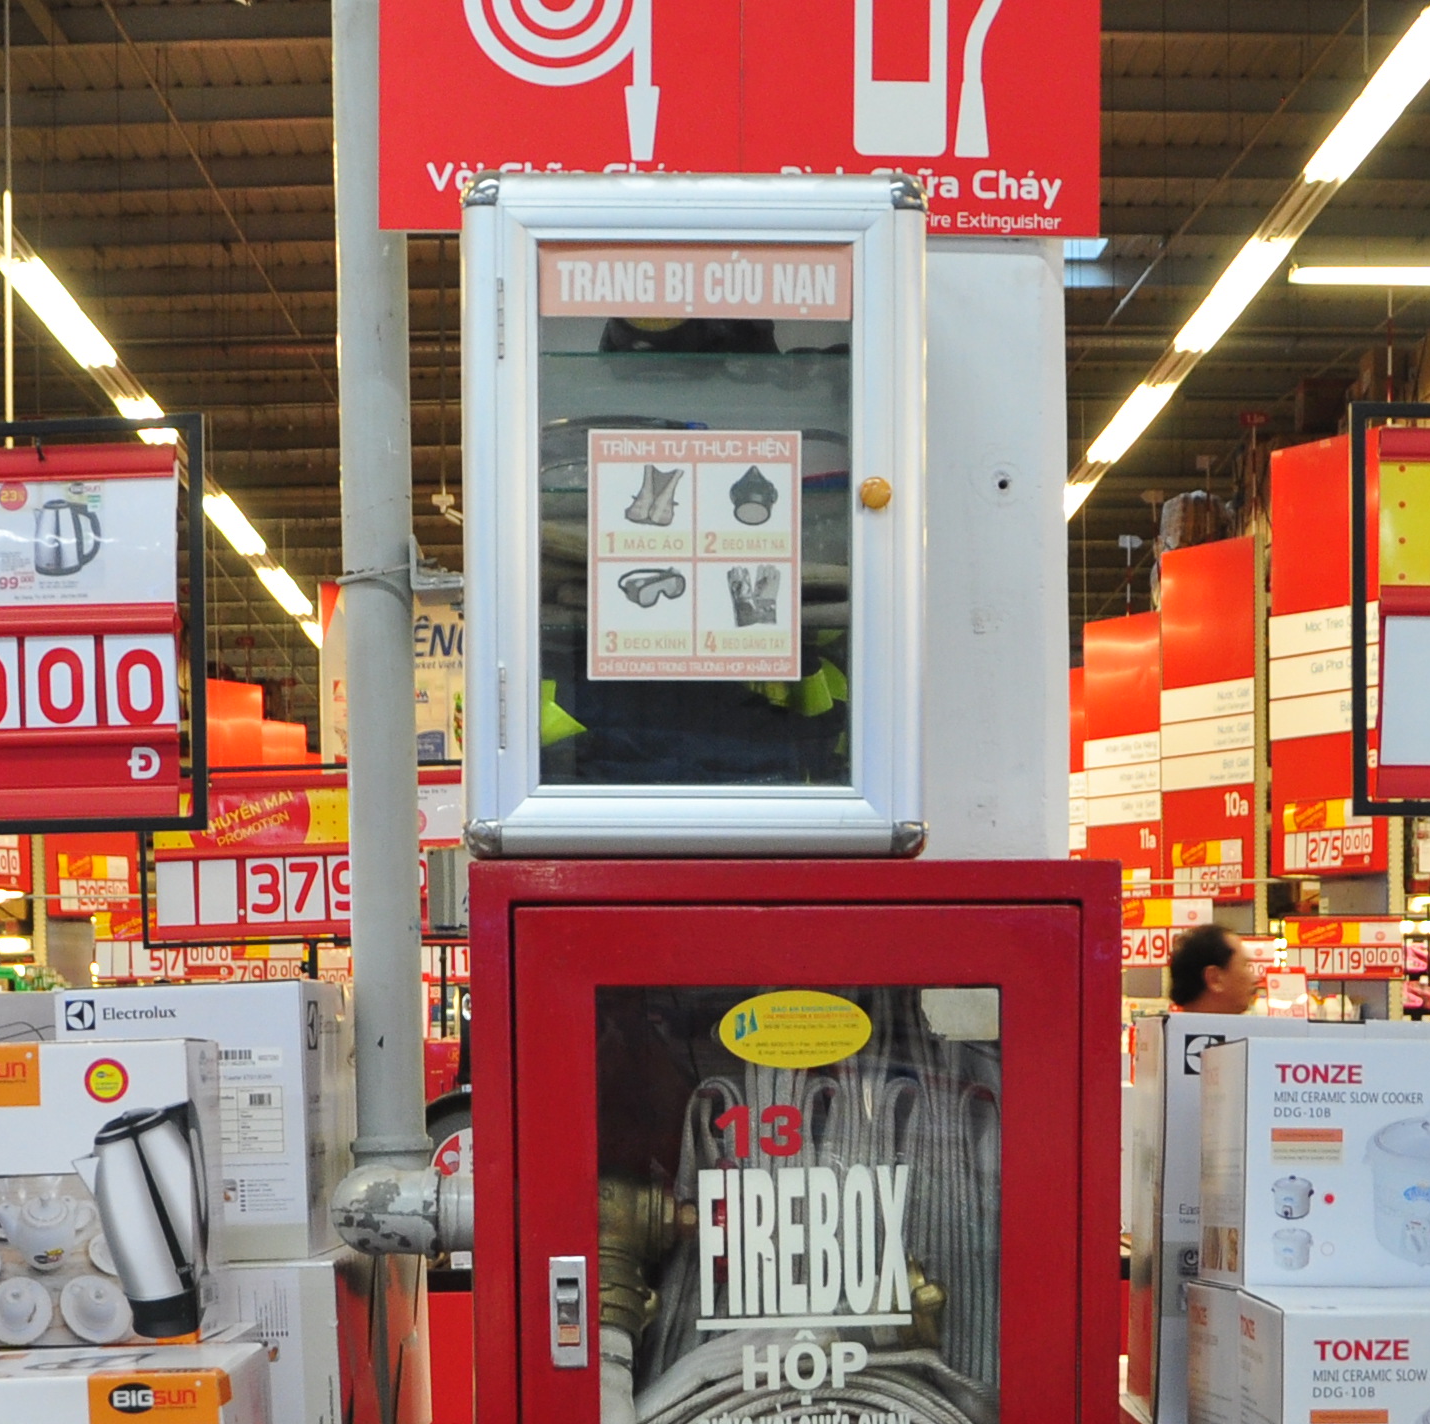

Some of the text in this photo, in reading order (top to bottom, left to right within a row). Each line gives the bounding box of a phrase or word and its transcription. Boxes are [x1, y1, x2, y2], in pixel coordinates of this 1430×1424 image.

[972, 169, 1062, 210] Cháy
[956, 211, 1062, 233] Extinguisher
[556, 250, 836, 315] TRANG BỊ CỨU NẠN
[600, 437, 656, 456] TRÌNH
[606, 532, 616, 554] 1
[703, 531, 717, 554] 2
[605, 630, 619, 653] 3
[703, 630, 717, 653] 4
[1223, 791, 1250, 818] 10a
[215, 809, 291, 847] PROMOTION
[101, 1004, 178, 1022] Electrolux
[1274, 1063, 1363, 1085] TONZE
[1273, 1090, 1424, 1105] MINI CERAMIC SLOW COOKER
[1273, 1106, 1332, 1119] DDG-10B
[714, 1104, 804, 1159] 13
[697, 1163, 912, 1318] FIREBOX
[1313, 1339, 1410, 1362] TONZE
[742, 1328, 869, 1406] HỘP
[1312, 1369, 1340, 1383] MINI
[1342, 1369, 1393, 1383] CERAMIC
[1395, 1368, 1428, 1382] SLOW
[1312, 1386, 1376, 1399] DDG-10B
